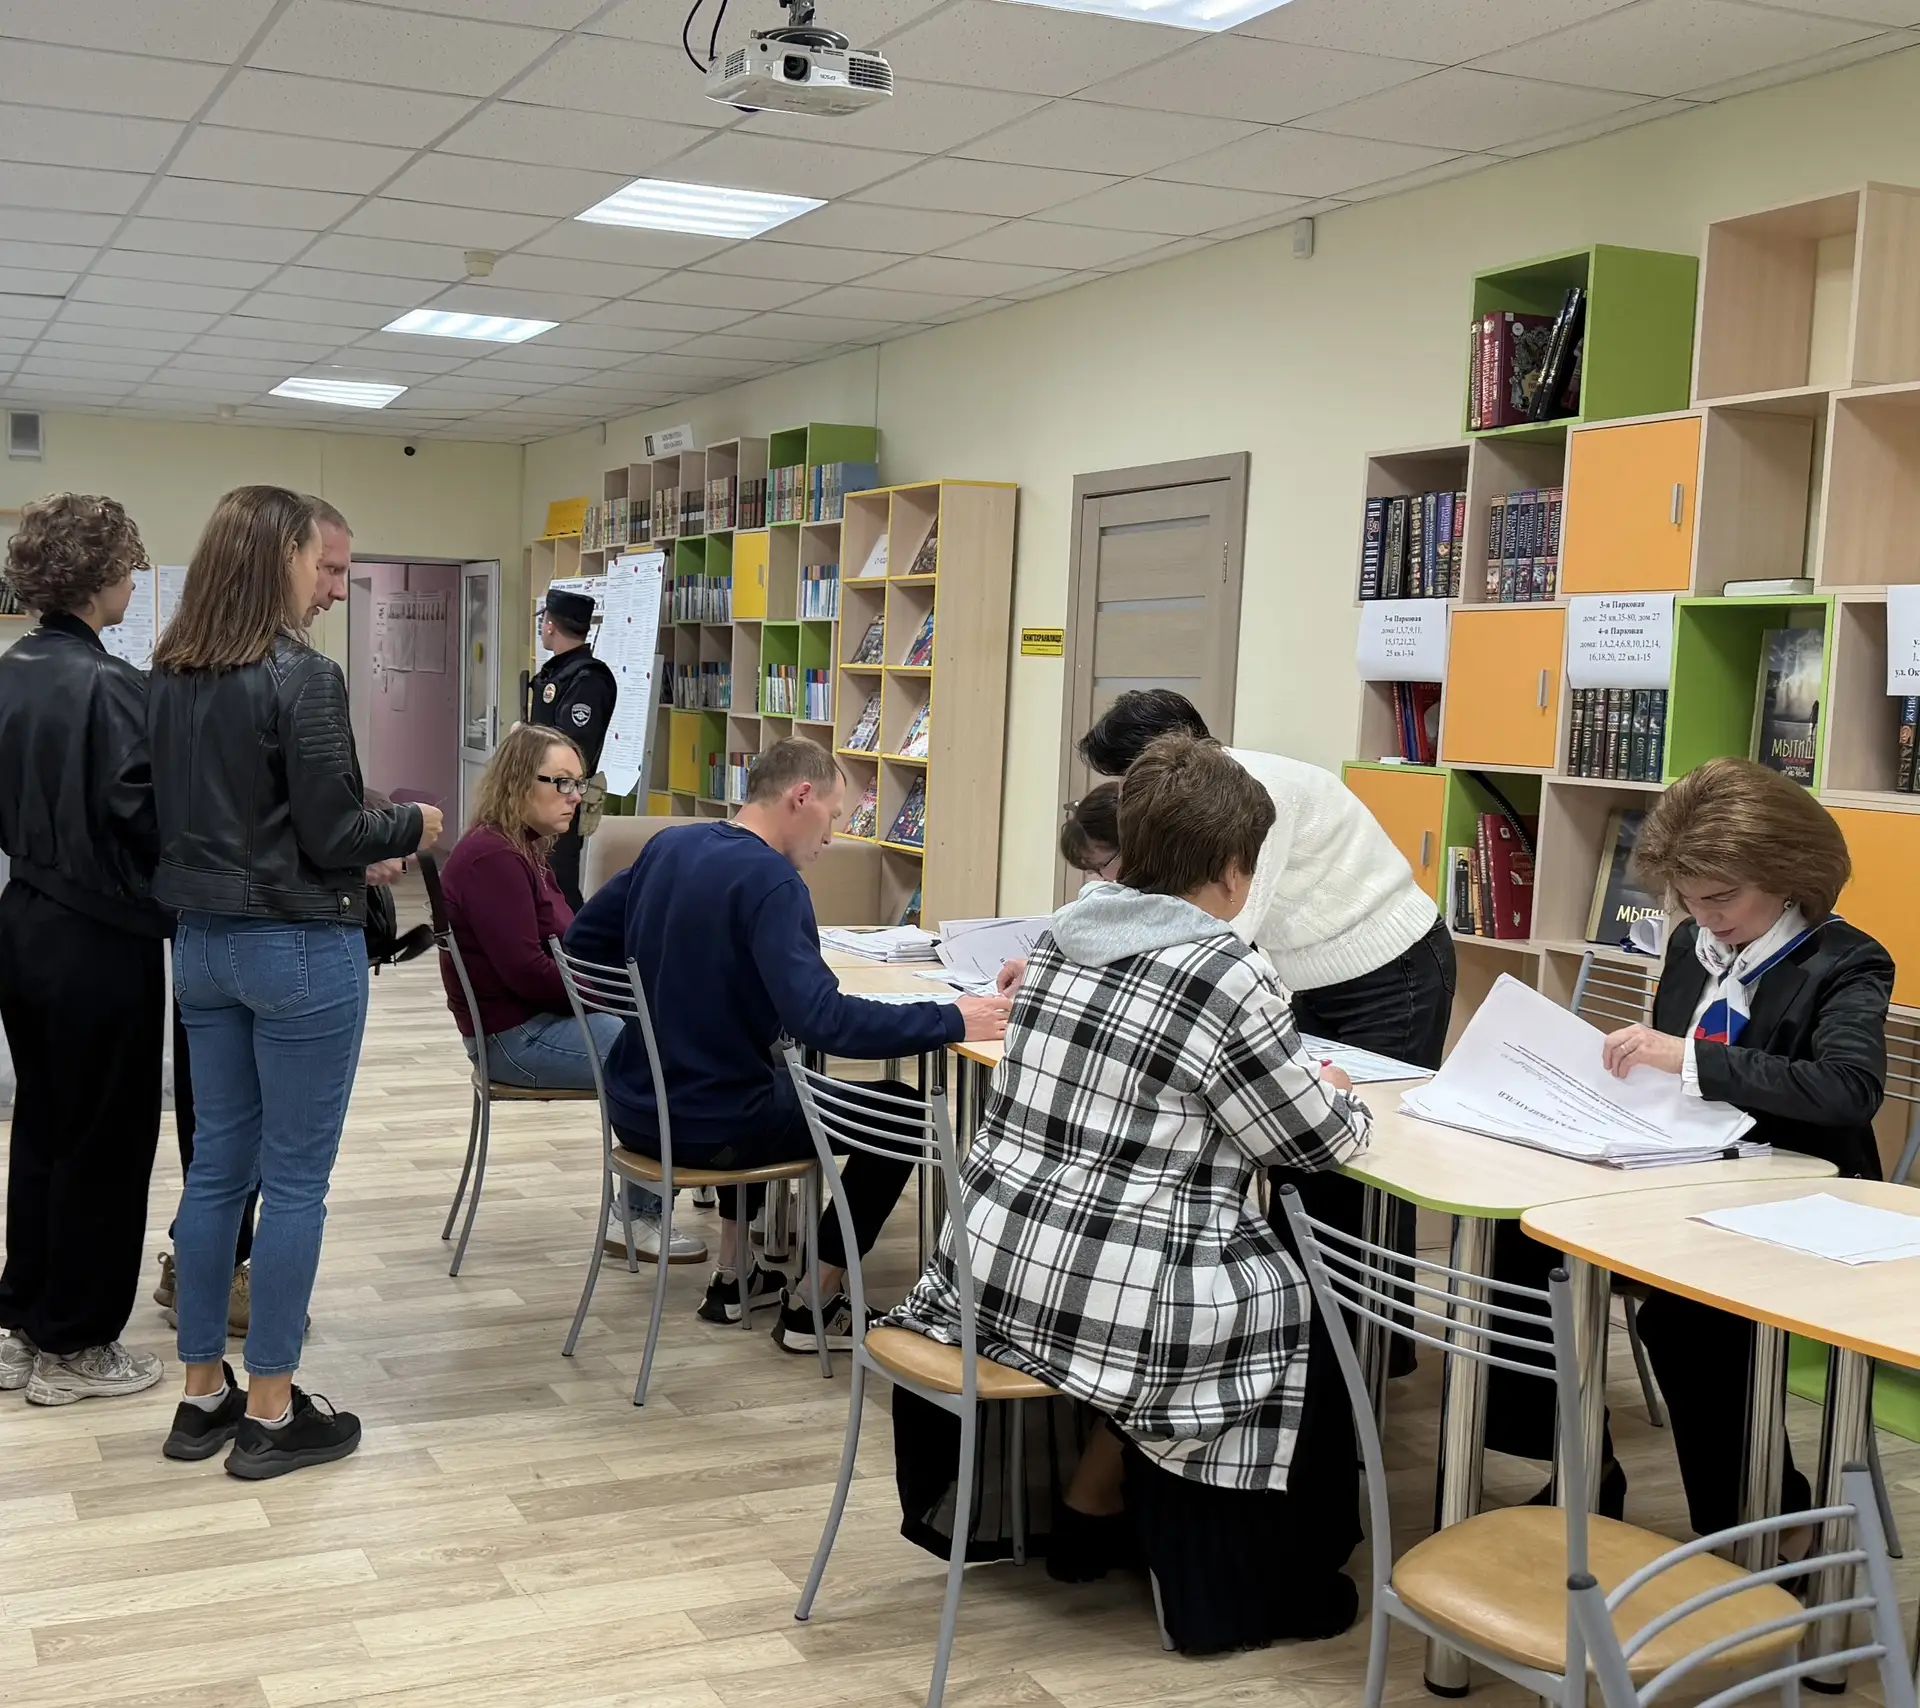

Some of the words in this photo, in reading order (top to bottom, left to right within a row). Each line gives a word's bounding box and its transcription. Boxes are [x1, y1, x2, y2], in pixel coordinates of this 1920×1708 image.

[1599, 601, 1610, 609] 3-я
[1612, 601, 1645, 610] Парковая
[1394, 615, 1422, 624] Парковая
[1599, 614, 1607, 622] 25
[1652, 613, 1660, 621] 27
[1610, 627, 1643, 636] Парковая
[1618, 653, 1626, 662] 22
